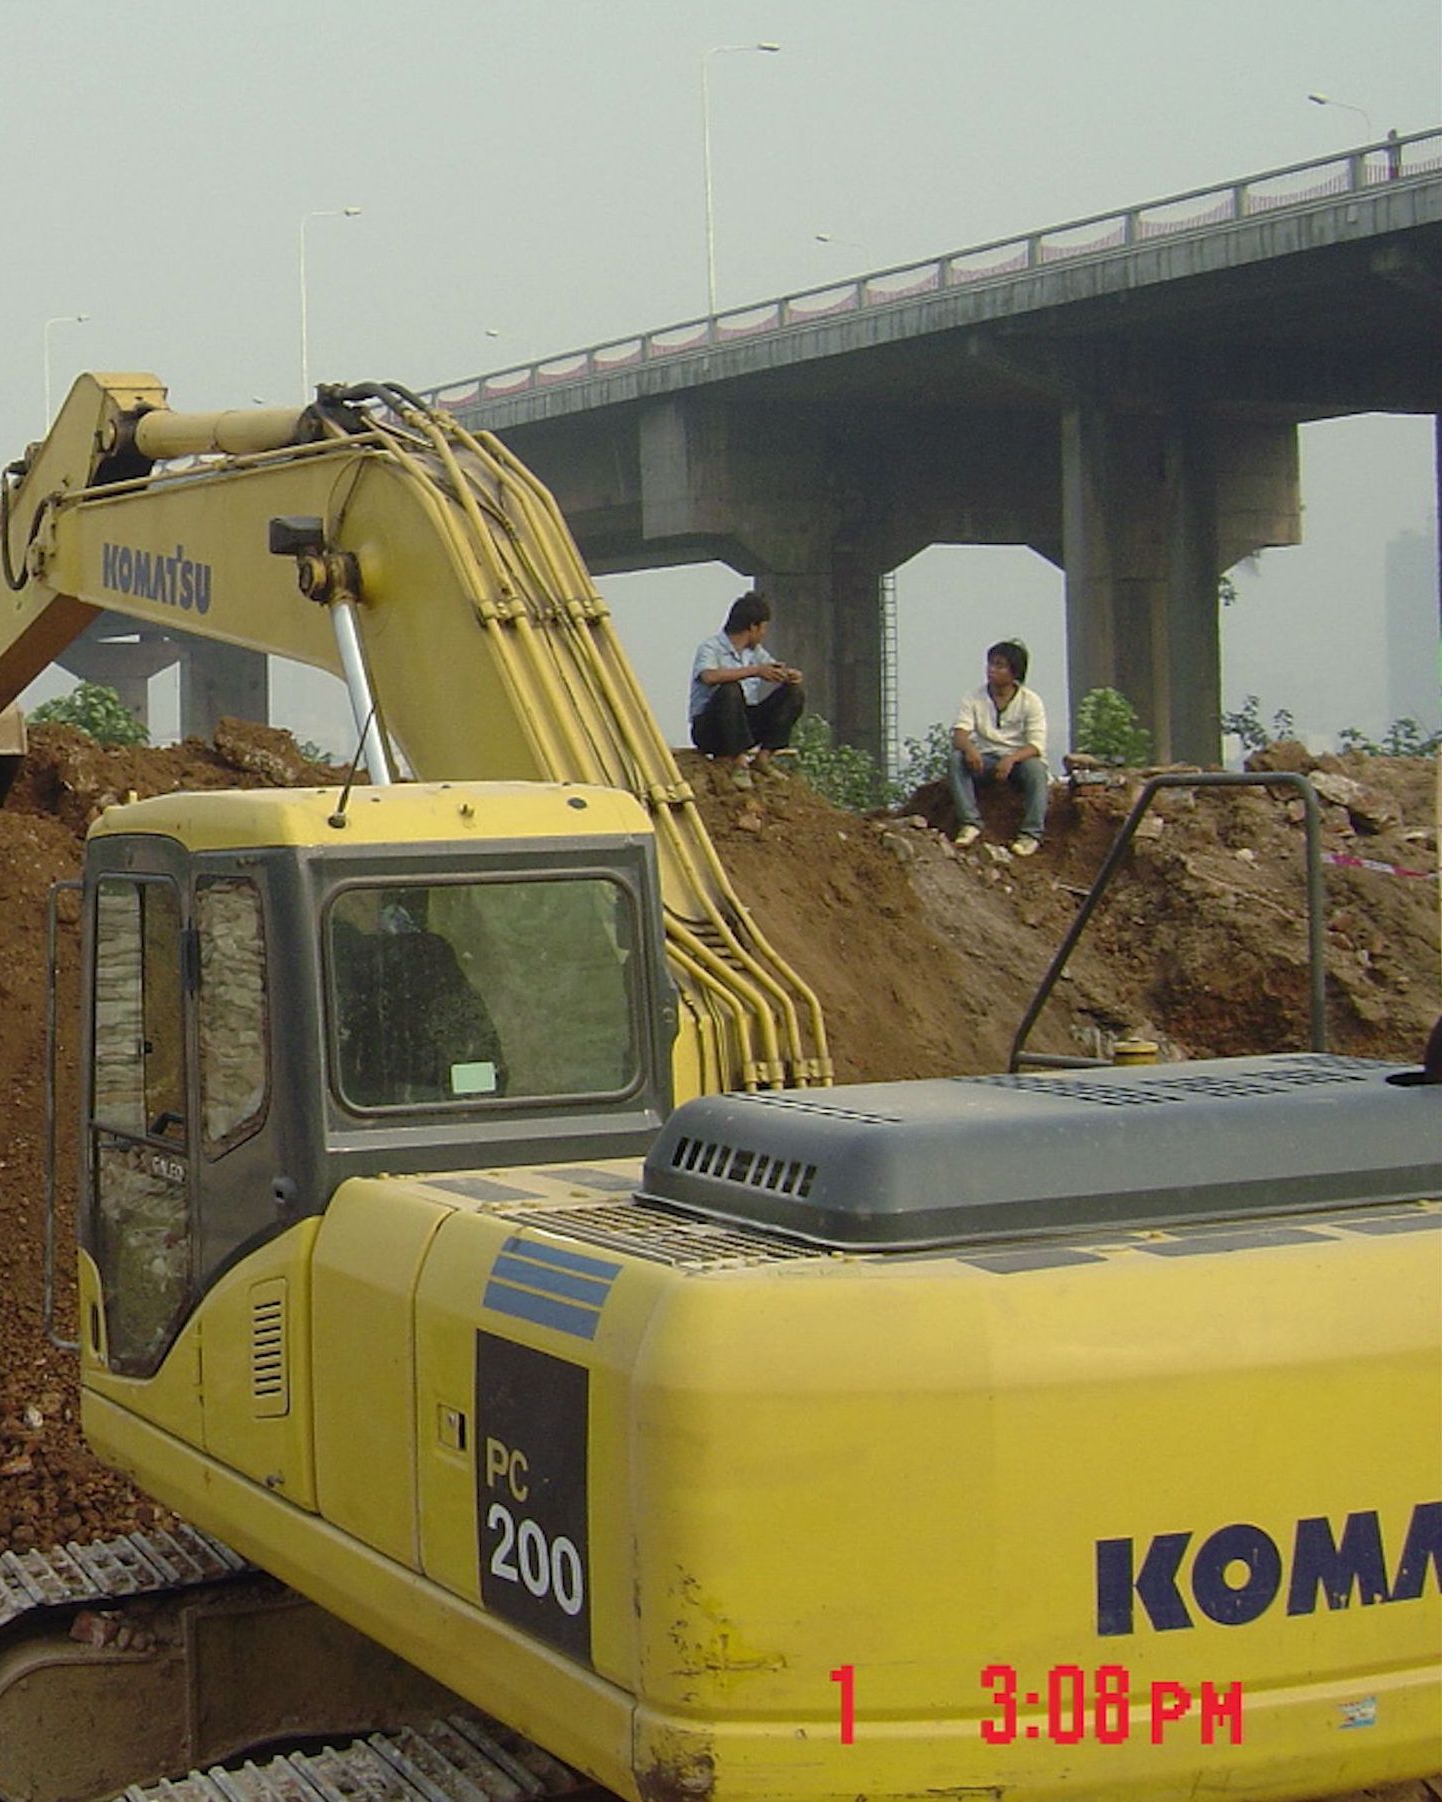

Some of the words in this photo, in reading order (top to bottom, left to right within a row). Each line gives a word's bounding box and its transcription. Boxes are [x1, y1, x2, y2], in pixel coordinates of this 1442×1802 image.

[103, 543, 211, 614] KOMATSU
[487, 1437, 528, 1502] PC
[487, 1503, 584, 1616] 200
